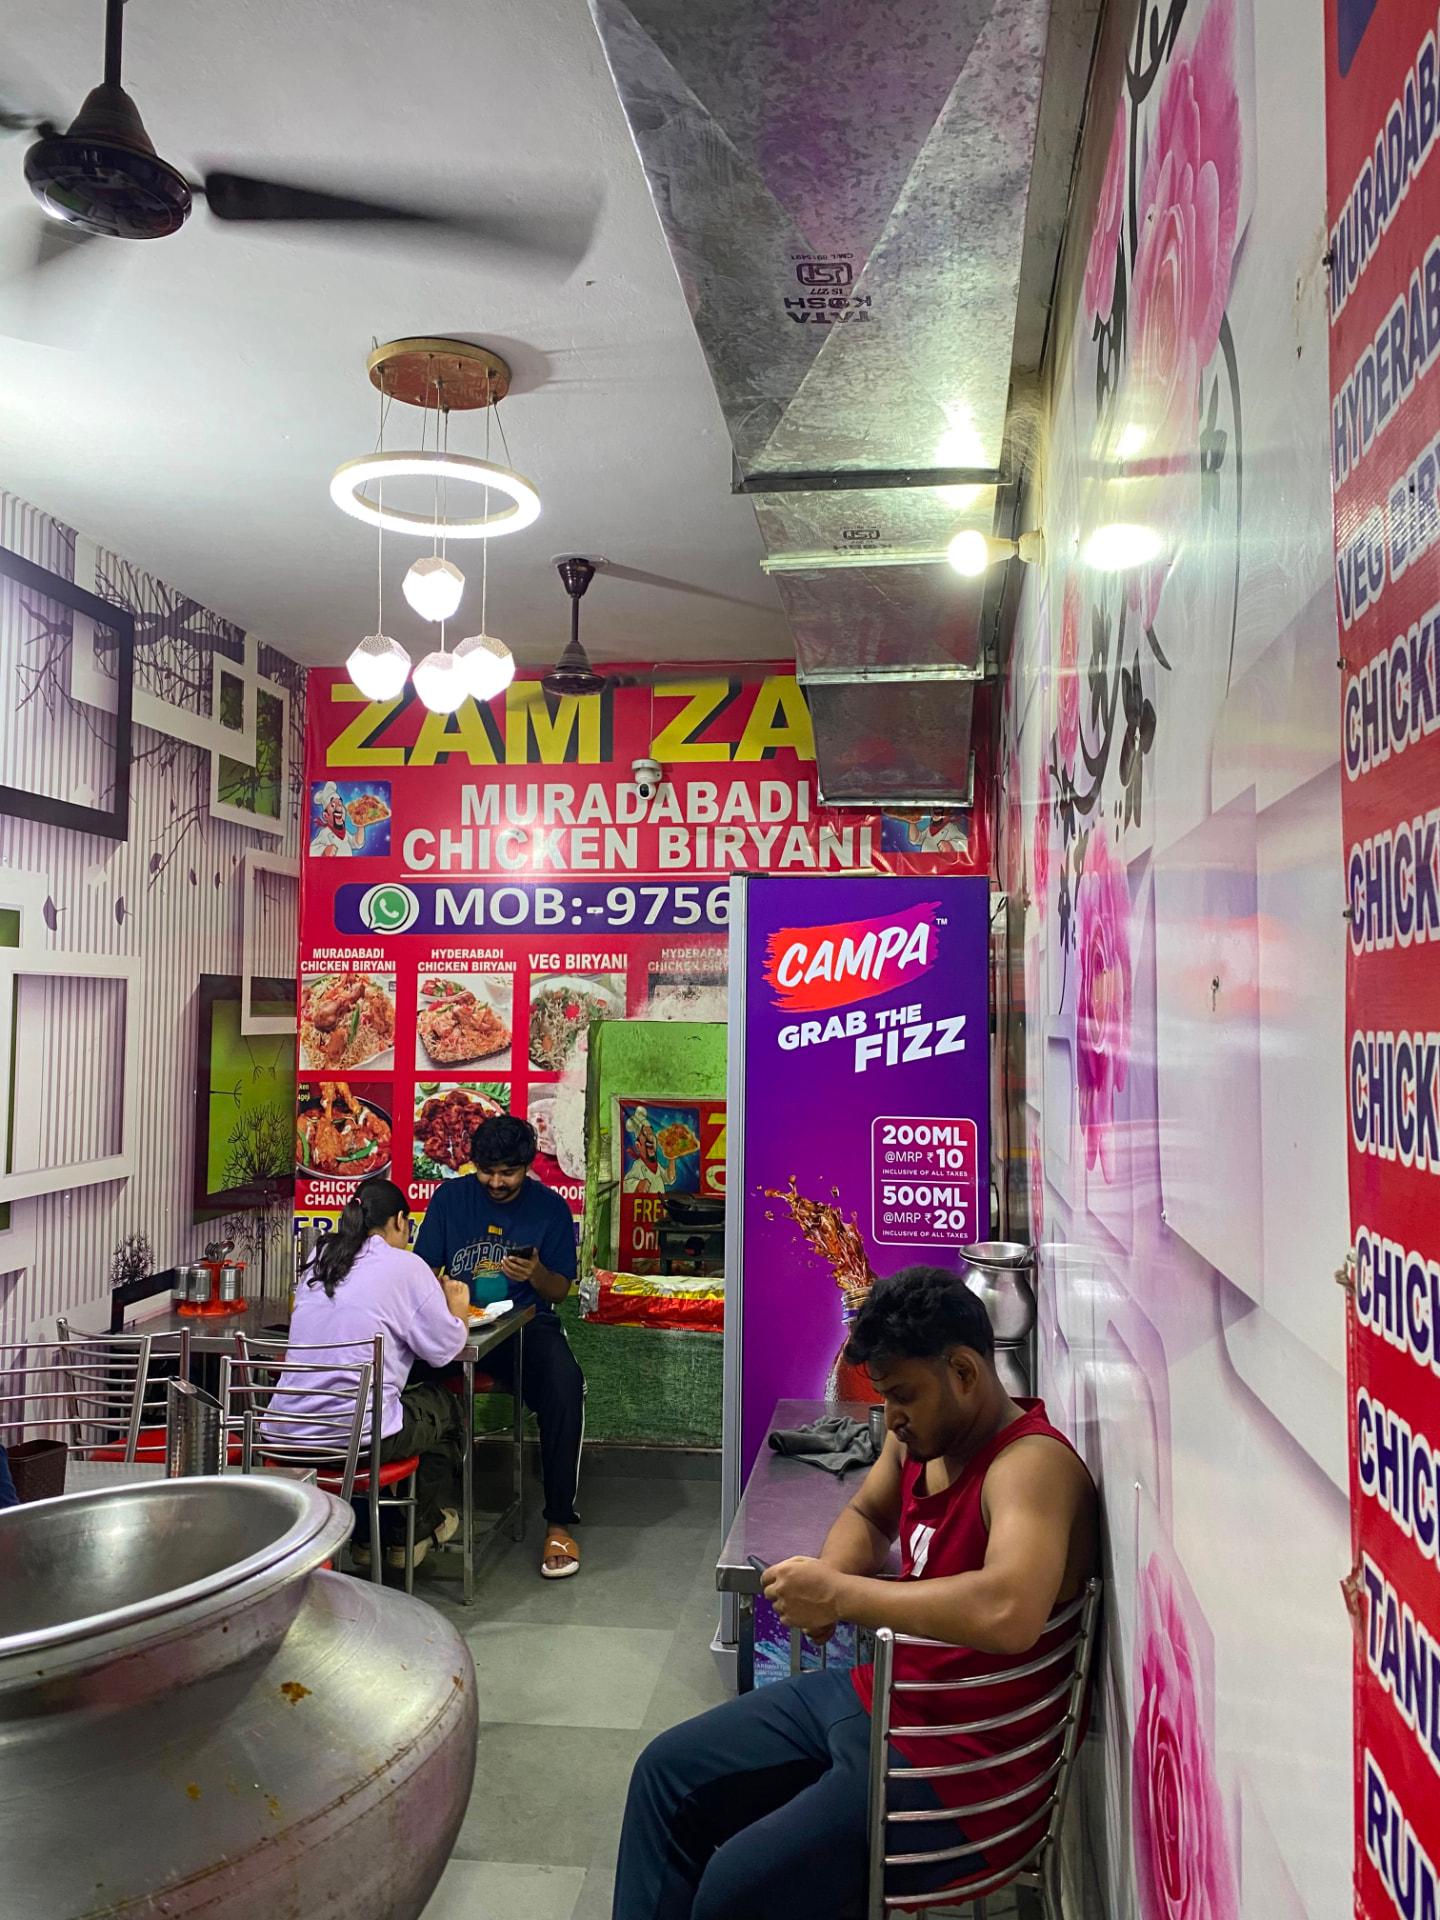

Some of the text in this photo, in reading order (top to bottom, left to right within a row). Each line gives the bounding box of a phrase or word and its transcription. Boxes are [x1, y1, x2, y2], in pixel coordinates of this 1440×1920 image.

[1331, 14, 1440, 325] MURADAB
[786, 311, 870, 324] TATA
[1337, 428, 1440, 630] VEG BIR
[1345, 612, 1440, 781] CHICK
[326, 680, 608, 767] ZAM
[461, 780, 809, 826] MURADABADI
[403, 826, 872, 871] CHICKEN BIRYANI
[313, 948, 384, 959] MURADABADI
[431, 949, 504, 959] HYDERABADI
[529, 954, 628, 969] VEG BIRYANI
[777, 922, 930, 987] CAMPA
[301, 961, 396, 971] CHICKEN BIRYANI
[417, 961, 517, 972] CHICKEN BIRYANI
[778, 1004, 922, 1050] GRAB THE
[855, 1015, 966, 1073] FIZZ
[882, 1125, 968, 1147] 200ML
[885, 1151, 922, 1163] @MRP
[309, 1181, 361, 1193] CHICK
[408, 1183, 442, 1200] CHI
[882, 1186, 968, 1208] 500ML
[883, 1211, 921, 1224] @MRP
[946, 1231, 968, 1239] TAXES
[450, 1242, 512, 1277] STRO
[1357, 1386, 1440, 1575] CHIC
